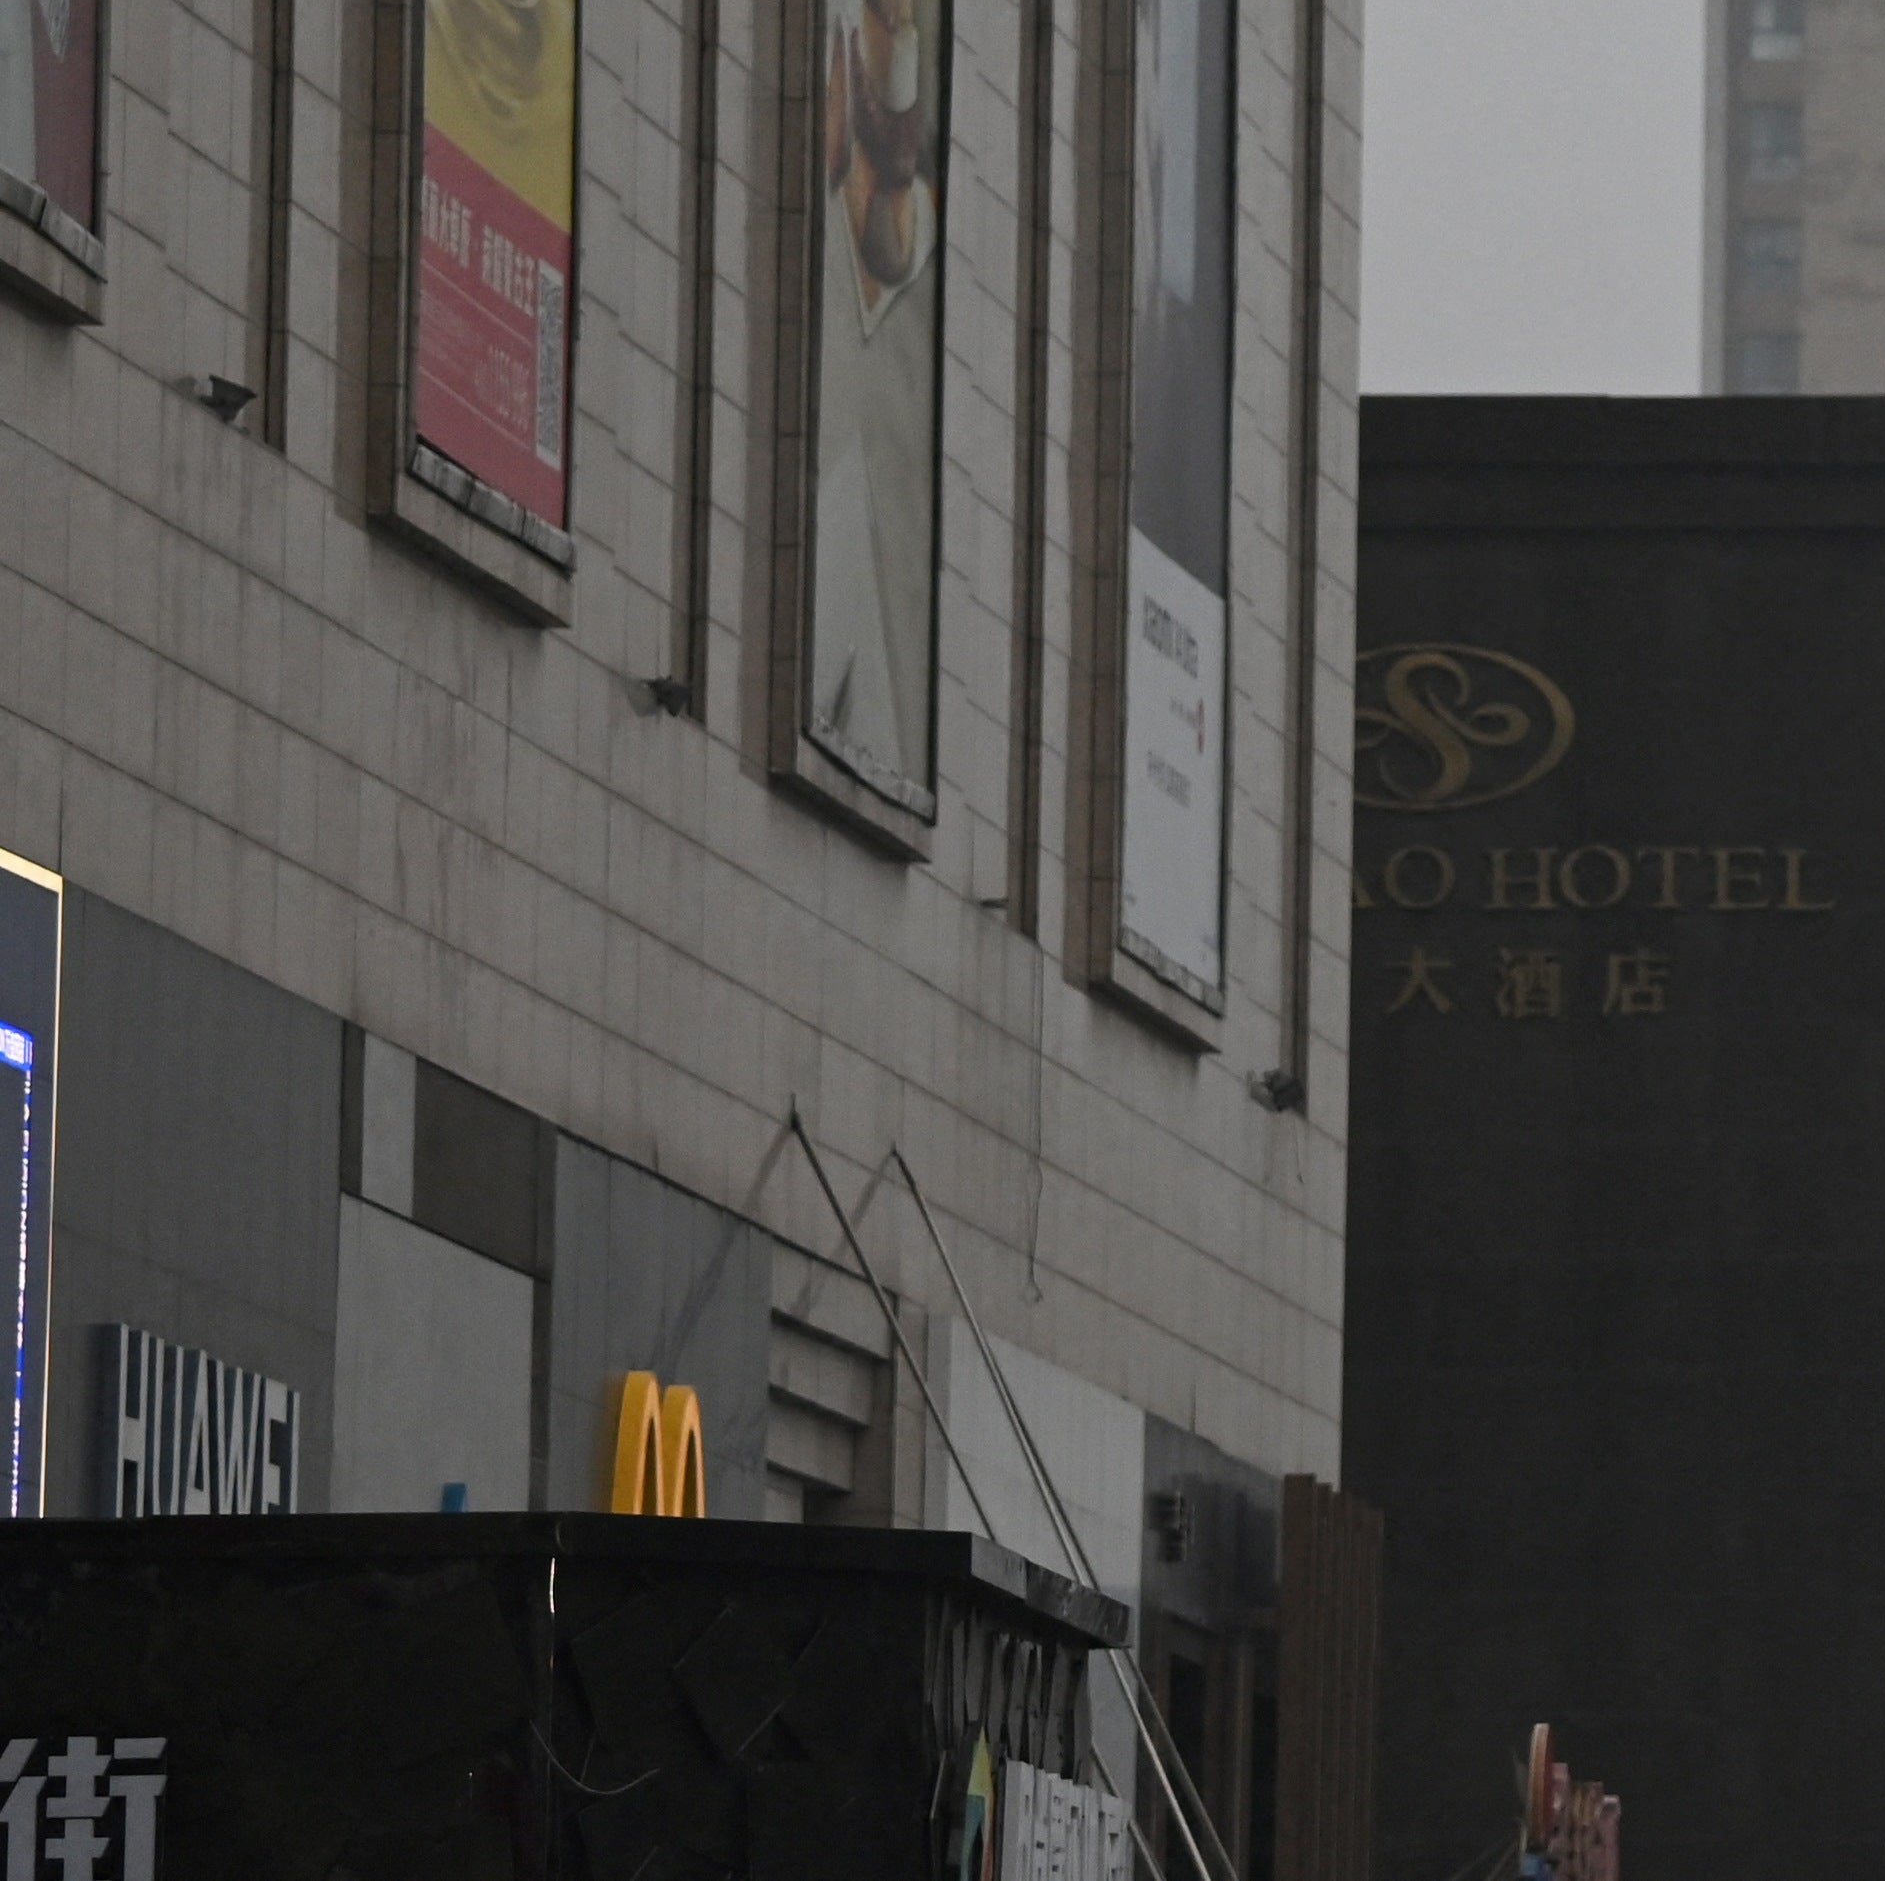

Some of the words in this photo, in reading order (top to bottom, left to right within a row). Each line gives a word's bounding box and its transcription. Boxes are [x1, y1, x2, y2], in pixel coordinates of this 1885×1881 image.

[1483, 844, 1837, 911] HOTEL
[1384, 944, 1672, 1019] 大酒店
[108, 1322, 301, 1519] HUAWEI
